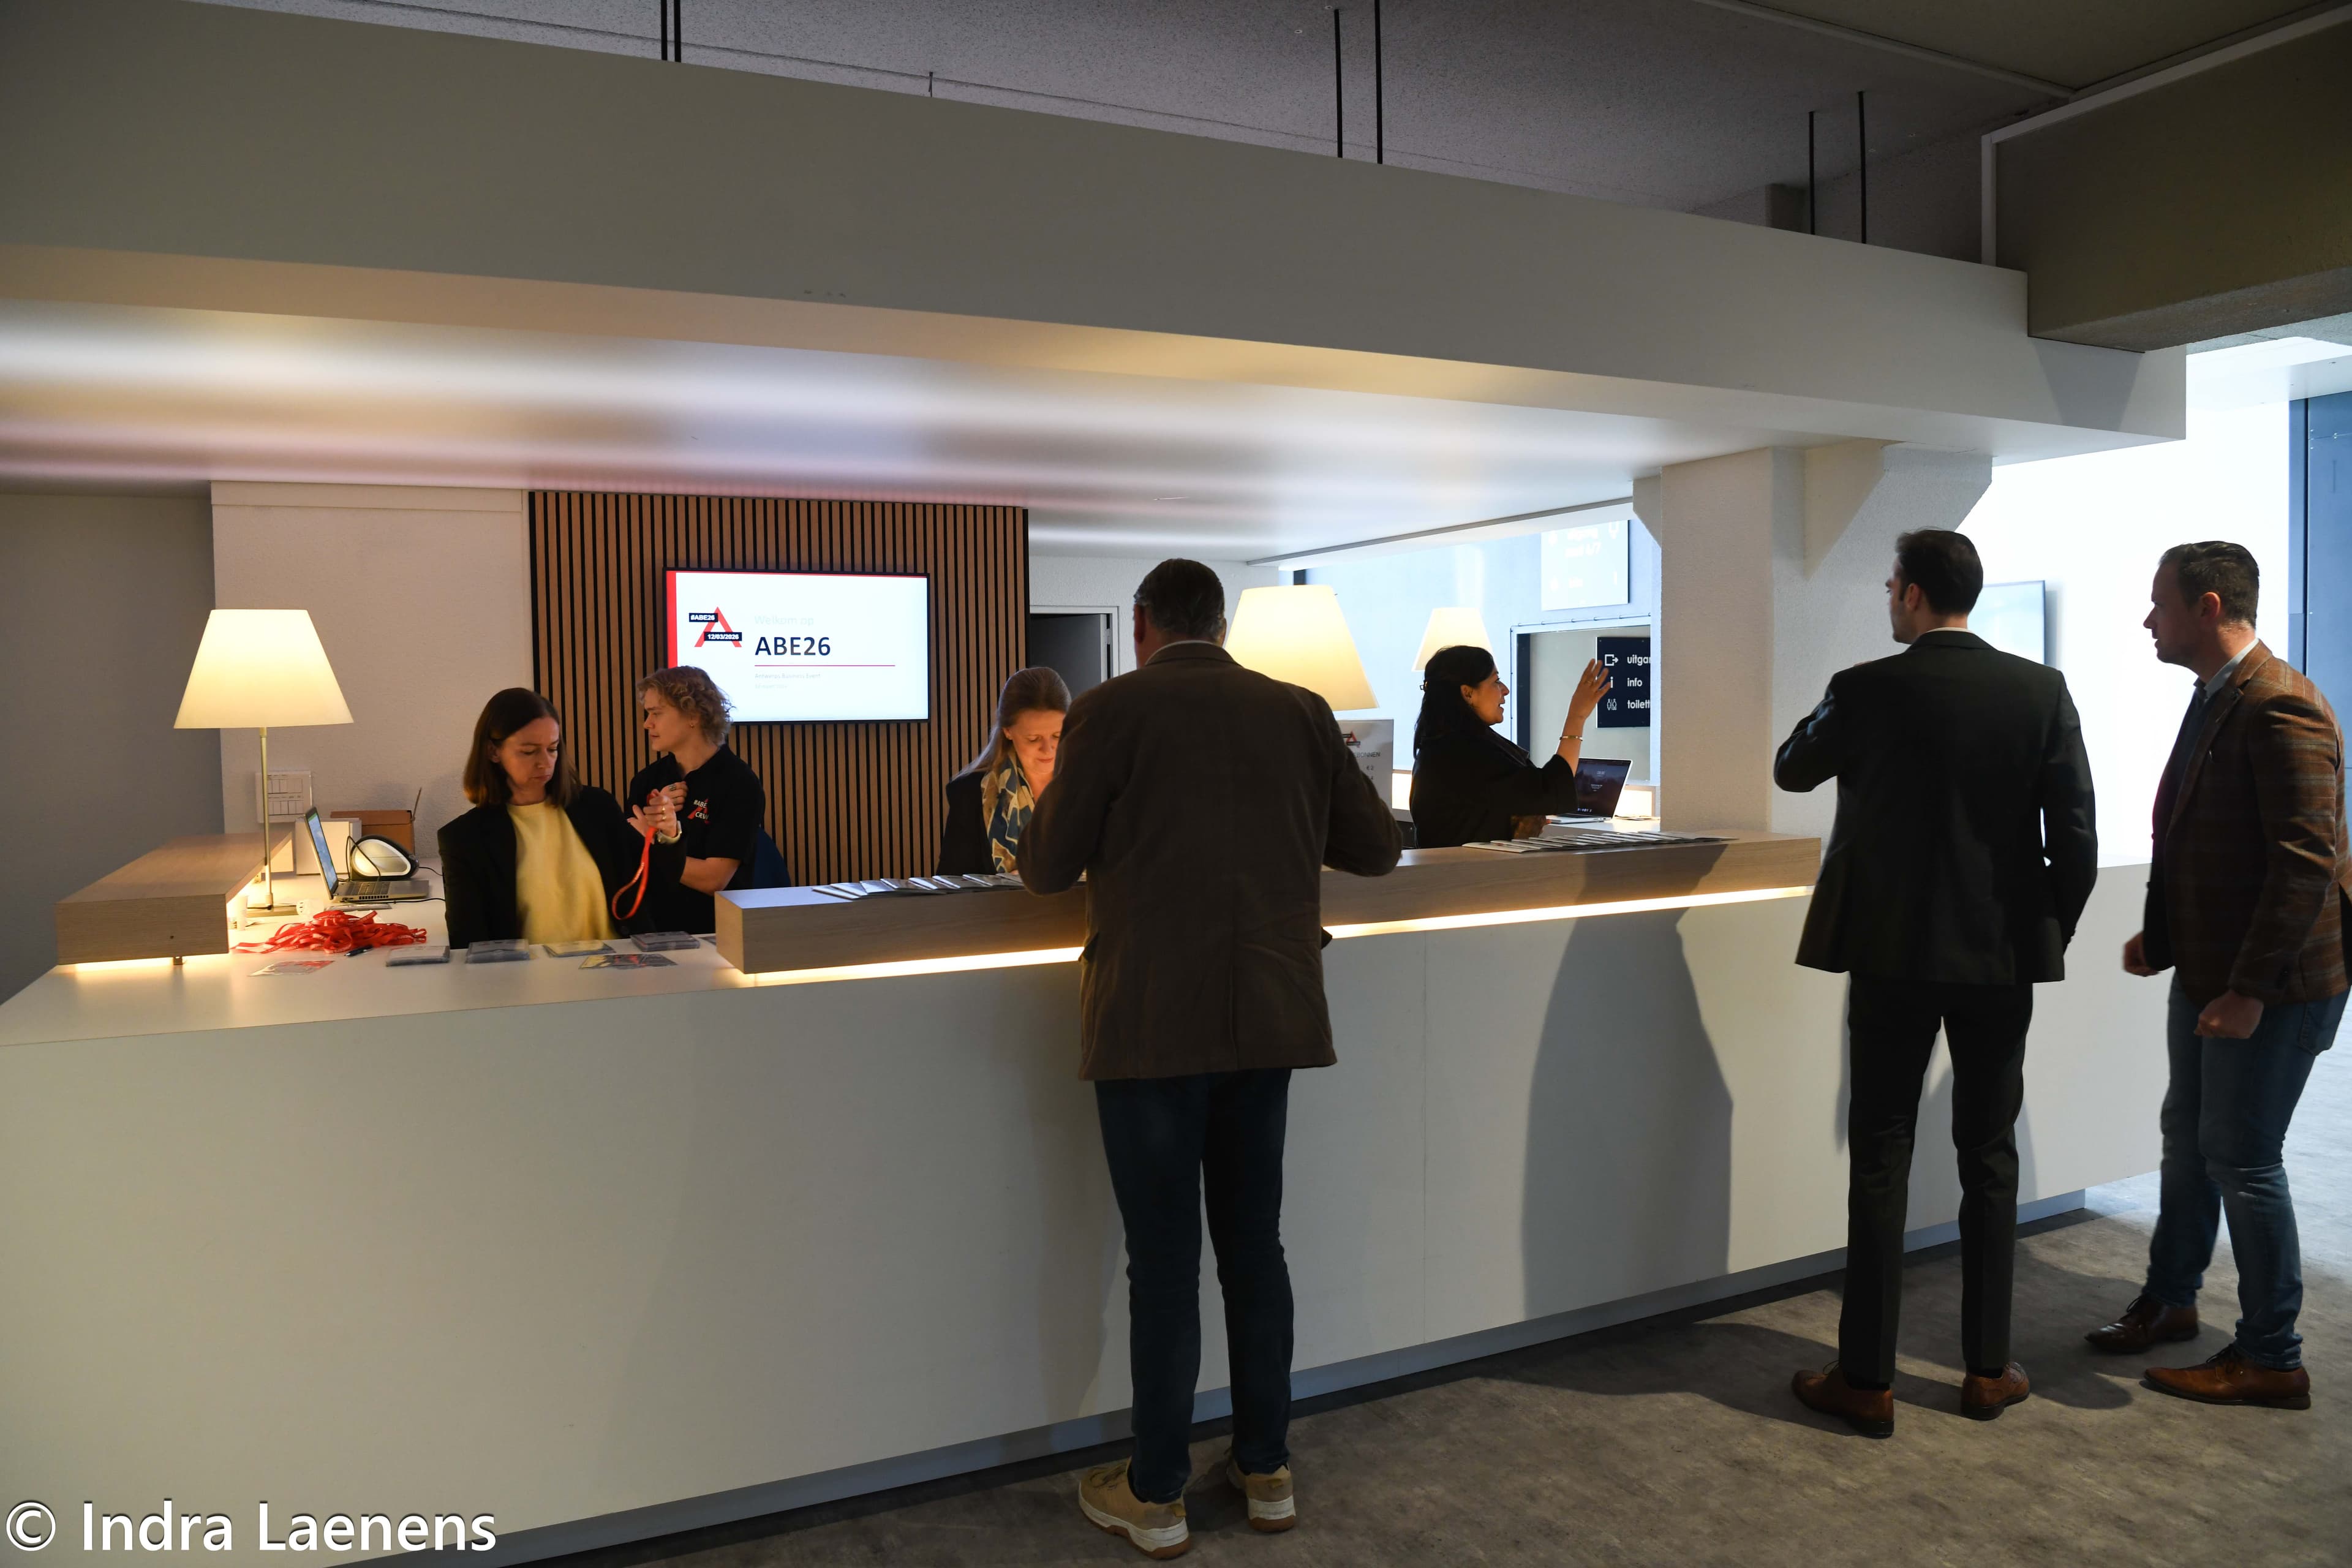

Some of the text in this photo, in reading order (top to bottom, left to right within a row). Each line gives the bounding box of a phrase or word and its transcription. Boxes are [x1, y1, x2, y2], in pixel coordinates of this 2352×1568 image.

[755, 615, 814, 626] Welkom op
[755, 636, 831, 656] ABE26
[1627, 677, 1643, 687] info
